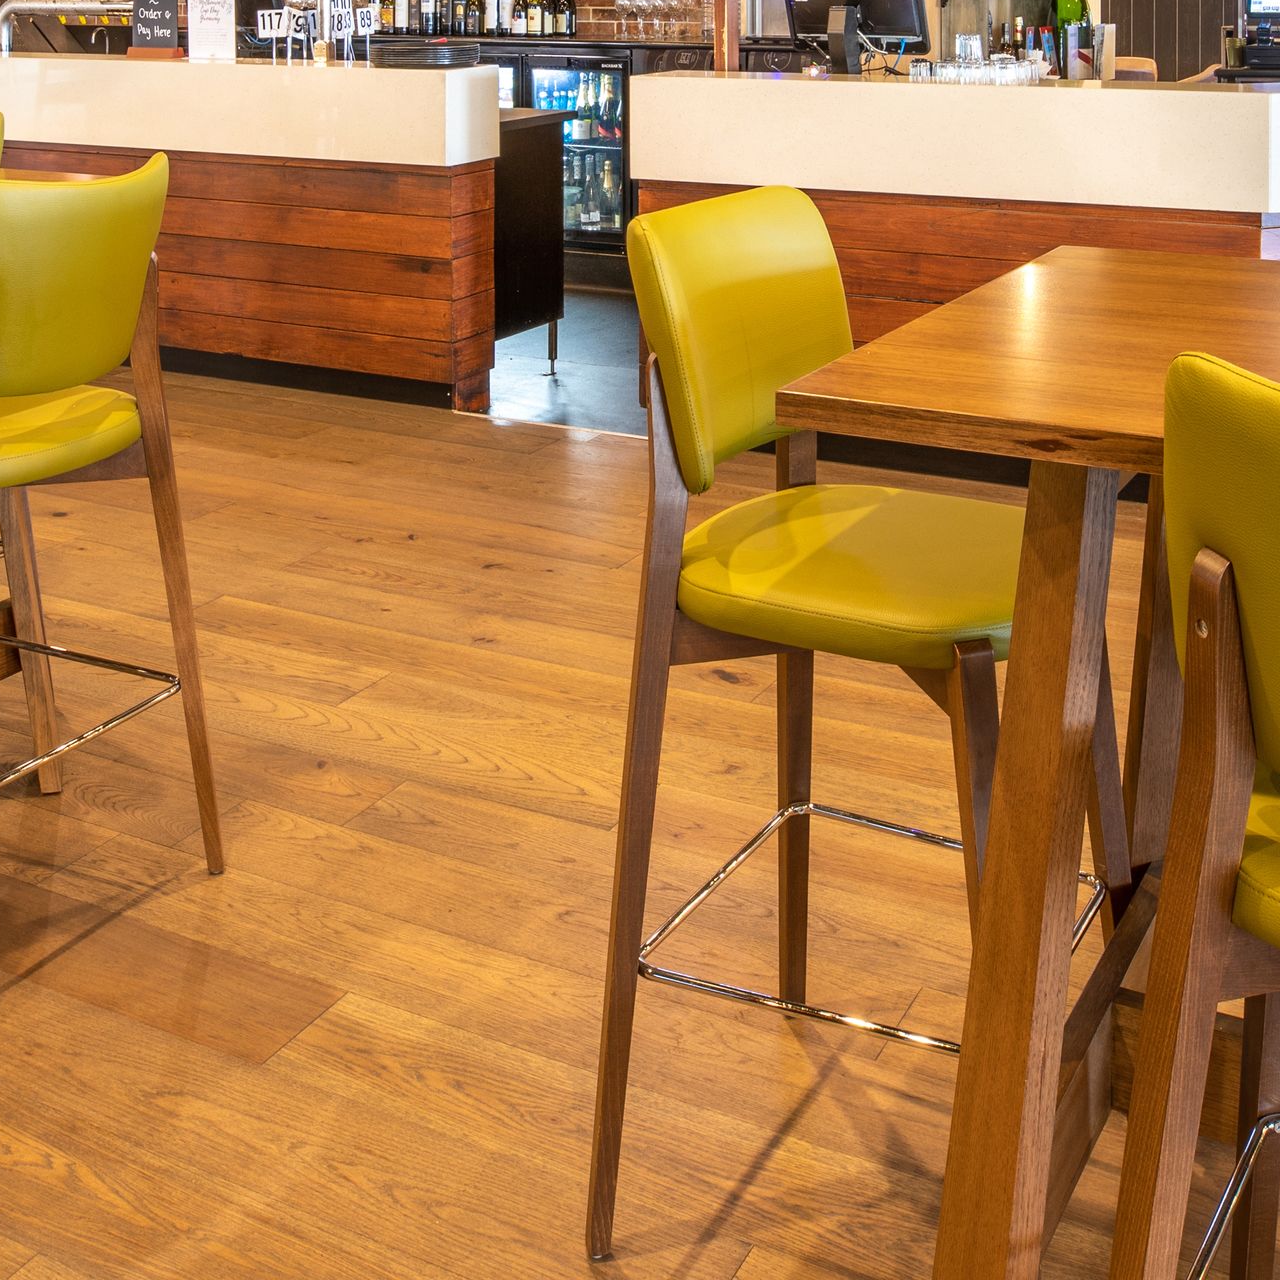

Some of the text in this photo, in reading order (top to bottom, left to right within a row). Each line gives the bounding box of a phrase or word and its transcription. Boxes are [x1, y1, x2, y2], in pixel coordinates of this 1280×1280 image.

[138, 7, 163, 20] Order
[260, 12, 283, 31] 117
[360, 10, 372, 28] 89
[137, 23, 171, 40] Pay Here
